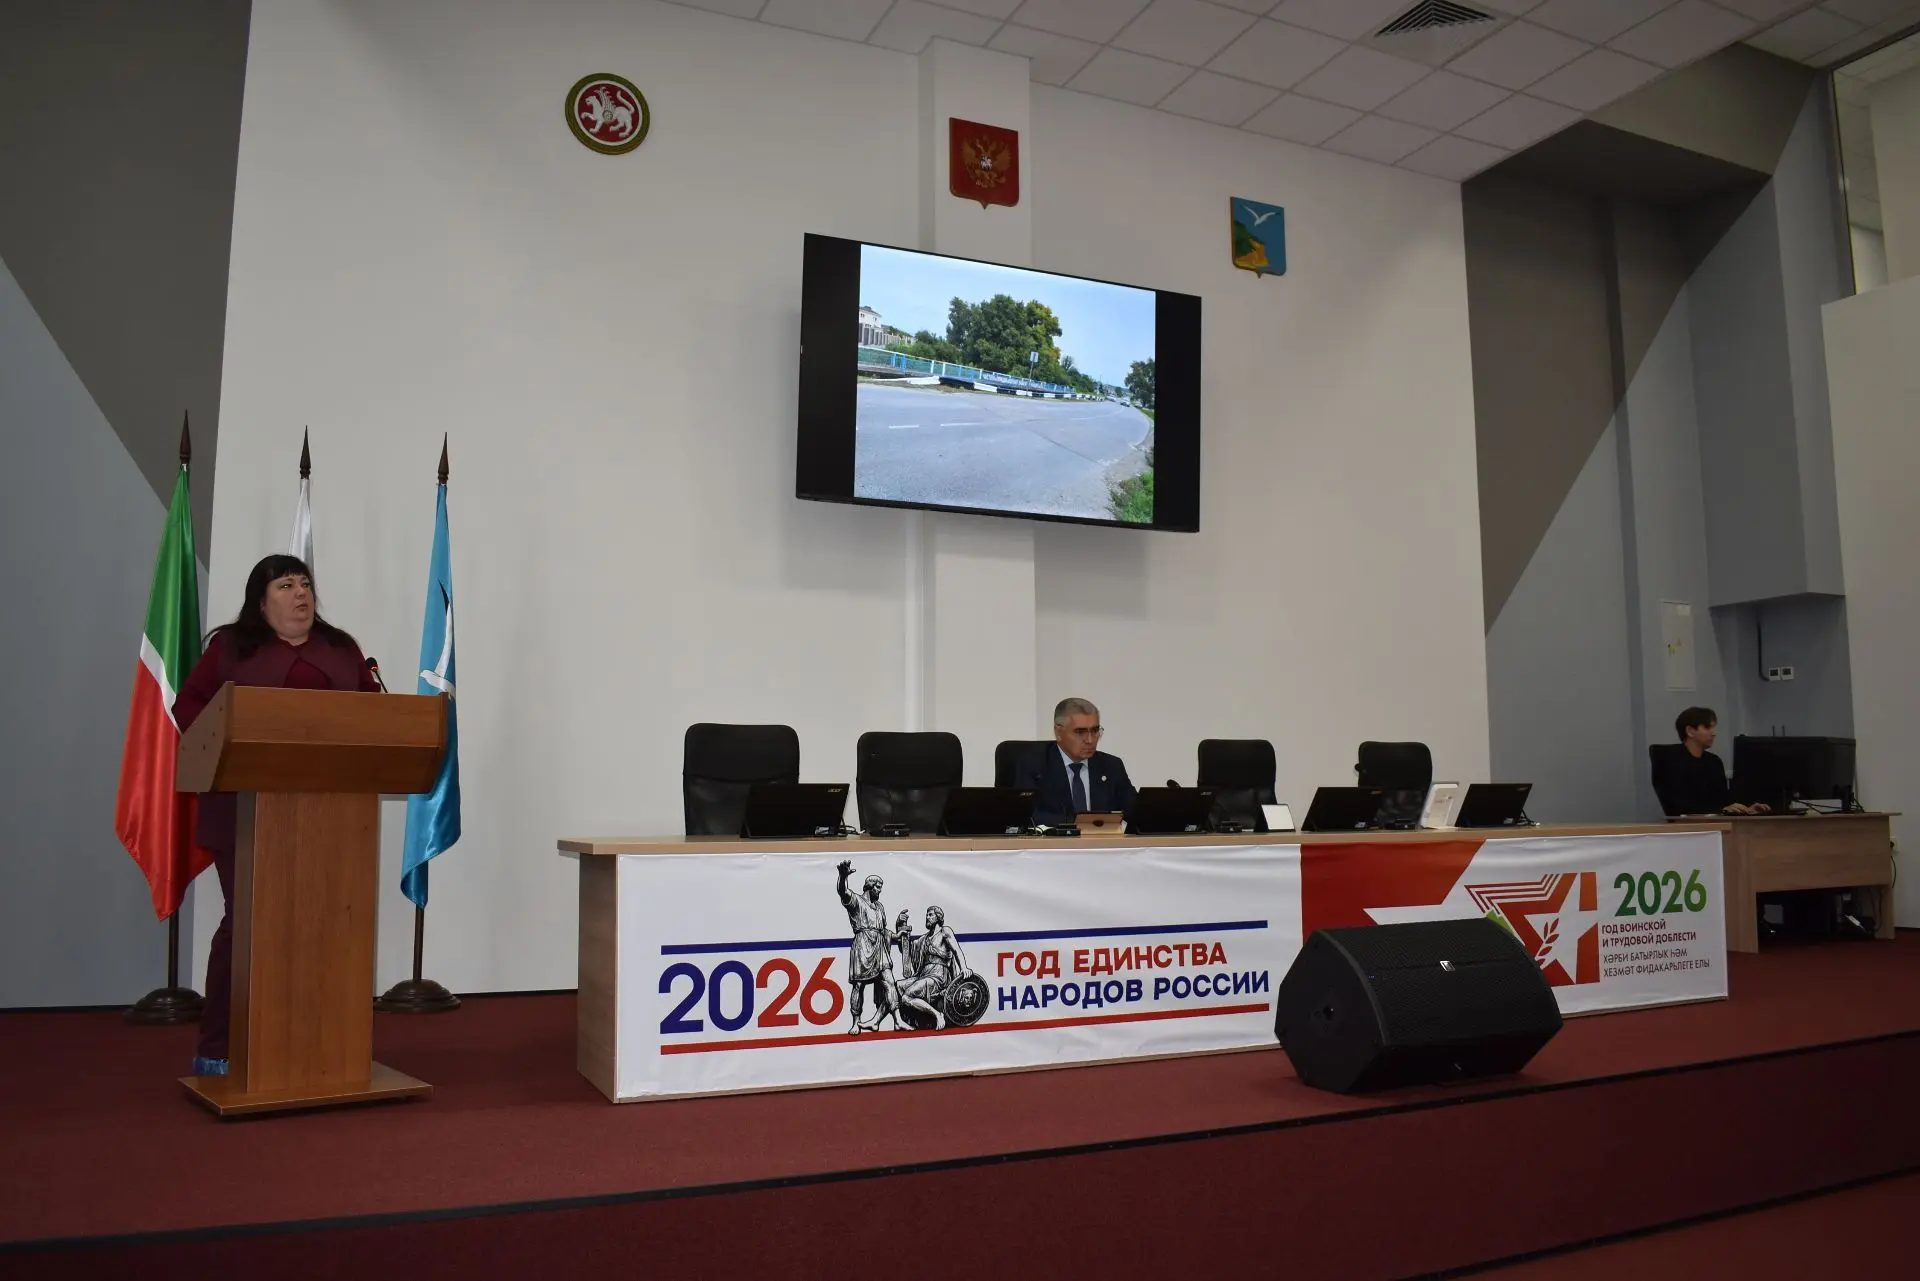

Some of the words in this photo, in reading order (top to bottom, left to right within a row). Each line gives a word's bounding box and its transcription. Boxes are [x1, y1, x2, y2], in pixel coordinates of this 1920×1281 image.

[1613, 868, 1708, 917] 2026
[1601, 924, 1619, 935] ГОД
[1620, 918, 1667, 934] ВОИНСКОЙ
[1602, 937, 1609, 948] И
[1610, 932, 1655, 948] ТРУДОВОЙ
[1655, 931, 1698, 945] ДОБЛЕСТИ
[997, 950, 1060, 979] ГОД
[1073, 942, 1228, 976] ЕДИНСТВА
[1603, 953, 1629, 964] ХӘРБИ
[1630, 948, 1670, 961] БАТЫРЛЫК
[1603, 965, 1635, 978] ХЕЗМӘТ
[1635, 961, 1694, 976] ФИДАКАРЬЛЕГЕ
[1695, 959, 1710, 969] ЕЛЫ
[658, 956, 845, 1035] 2026
[997, 978, 1143, 1011] НАРОДОВ
[1153, 970, 1269, 1001] РОССИИ
